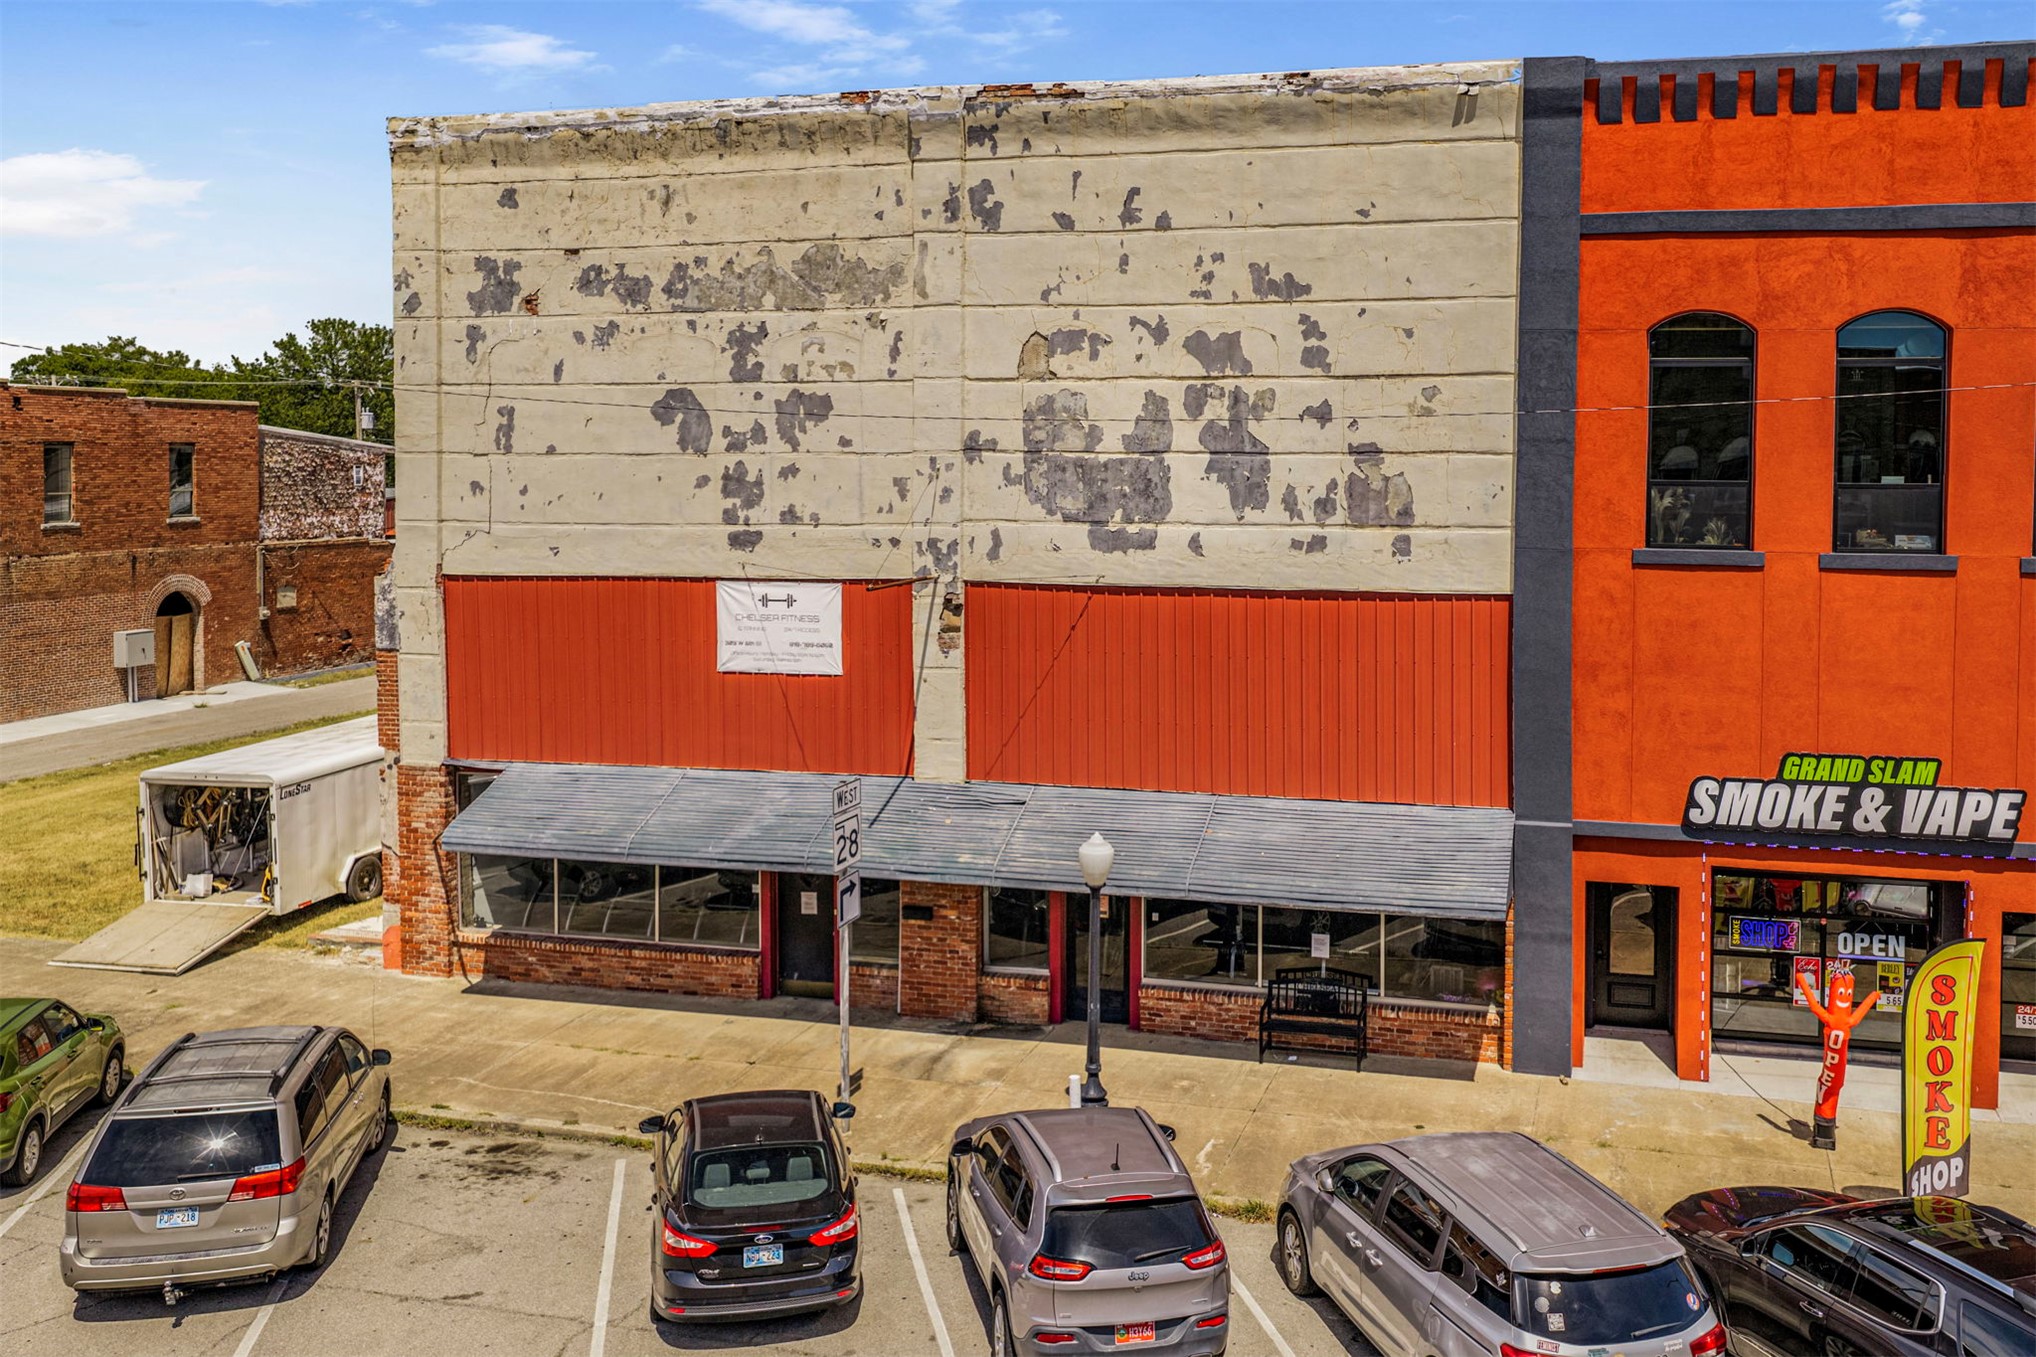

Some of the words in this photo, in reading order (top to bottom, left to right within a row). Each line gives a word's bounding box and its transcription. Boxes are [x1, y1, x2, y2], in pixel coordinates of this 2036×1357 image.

[735, 613, 779, 622] CHELSEA
[781, 614, 820, 623] FITNESS
[1782, 755, 1865, 783] GRAND
[1867, 759, 1938, 786] SLAM
[836, 786, 858, 809] WEST
[1688, 778, 1850, 831] SMOKE
[1852, 786, 1892, 833] &
[1900, 788, 2024, 838] VAPE
[836, 828, 859, 866] 28
[1732, 919, 1741, 945] SMOKE
[1740, 919, 1788, 949] SHOP
[1837, 932, 1906, 958] OPEN
[1925, 974, 1957, 1150] SMOKE
[1911, 1157, 1964, 1197] SHOP
[1128, 1272, 1149, 1281] Jeep
